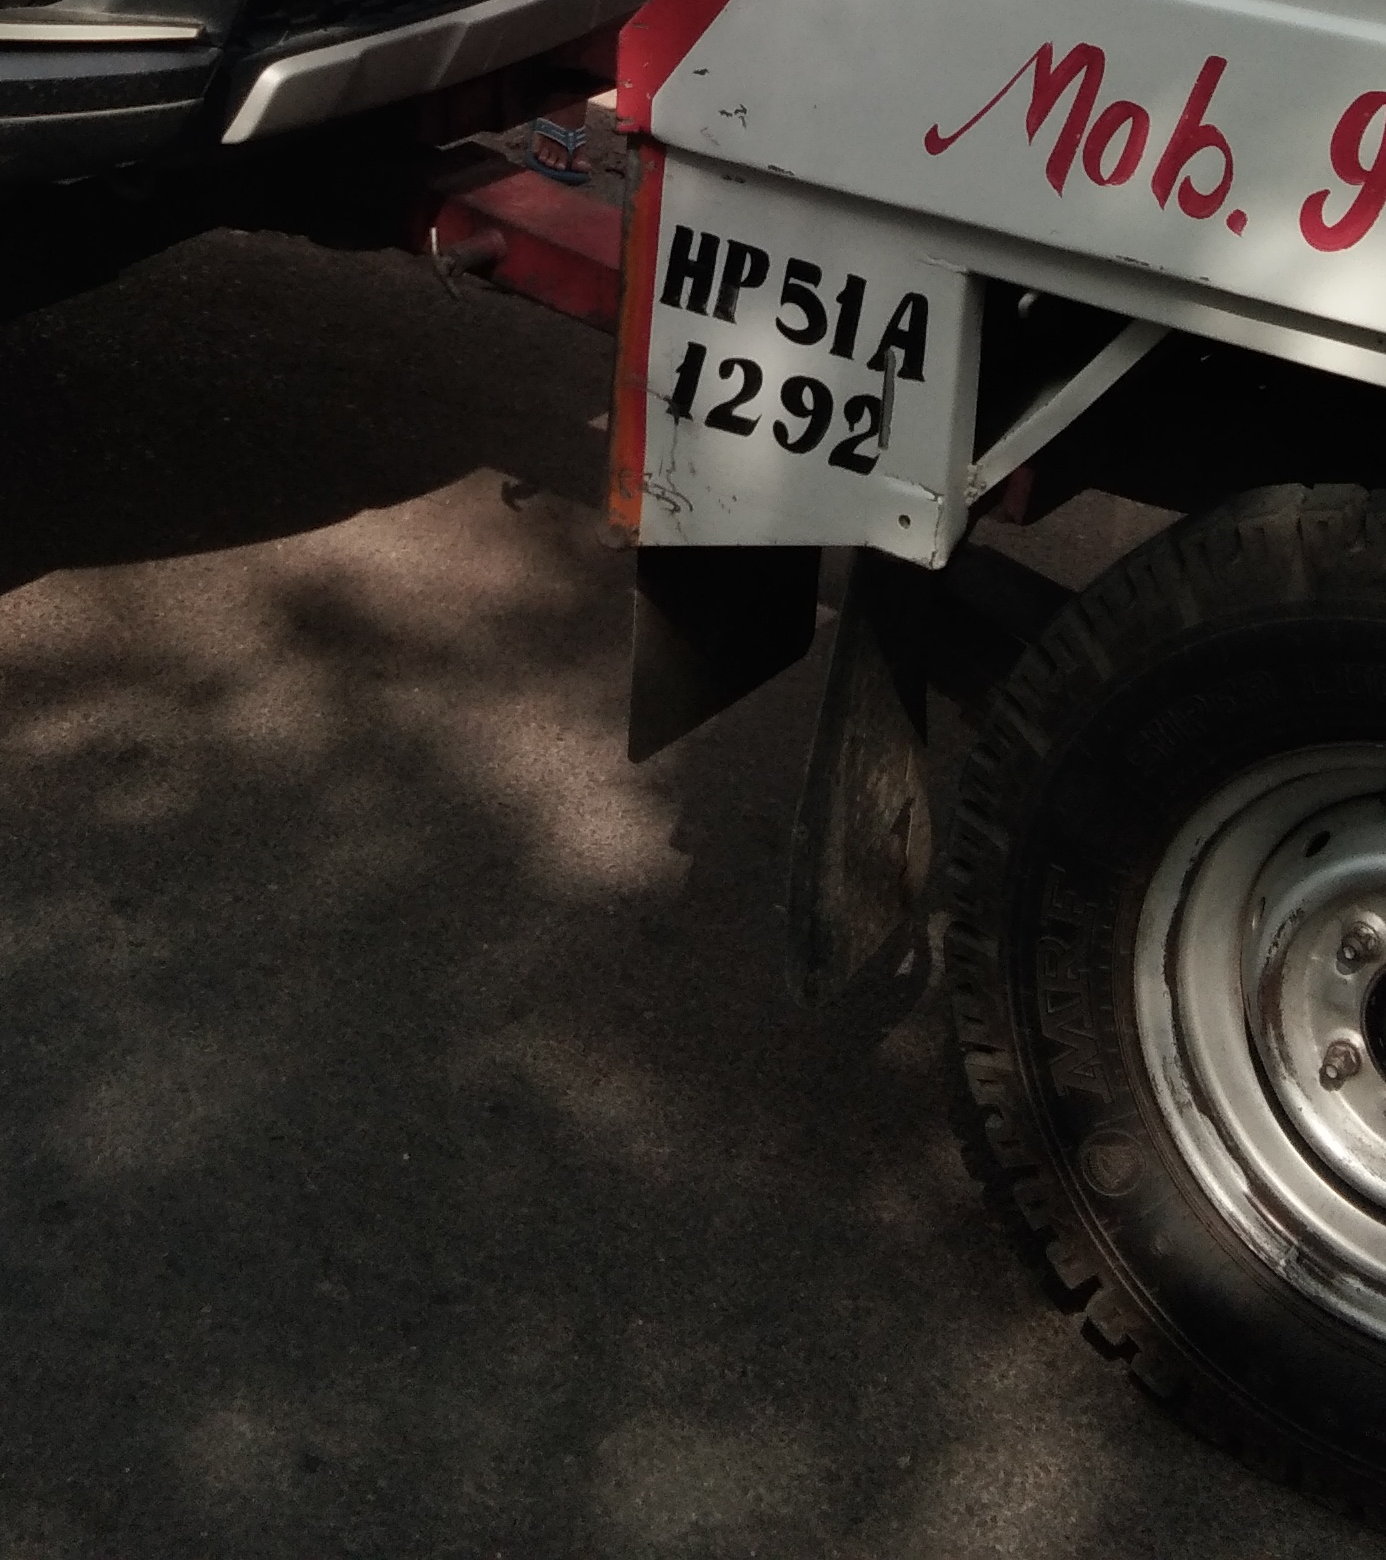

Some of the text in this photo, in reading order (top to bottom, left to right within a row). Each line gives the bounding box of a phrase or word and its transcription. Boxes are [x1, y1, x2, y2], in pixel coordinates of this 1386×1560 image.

[924, 41, 1247, 237] Mob.
[666, 341, 883, 476] 1292
[1035, 861, 1115, 1105] MRF
